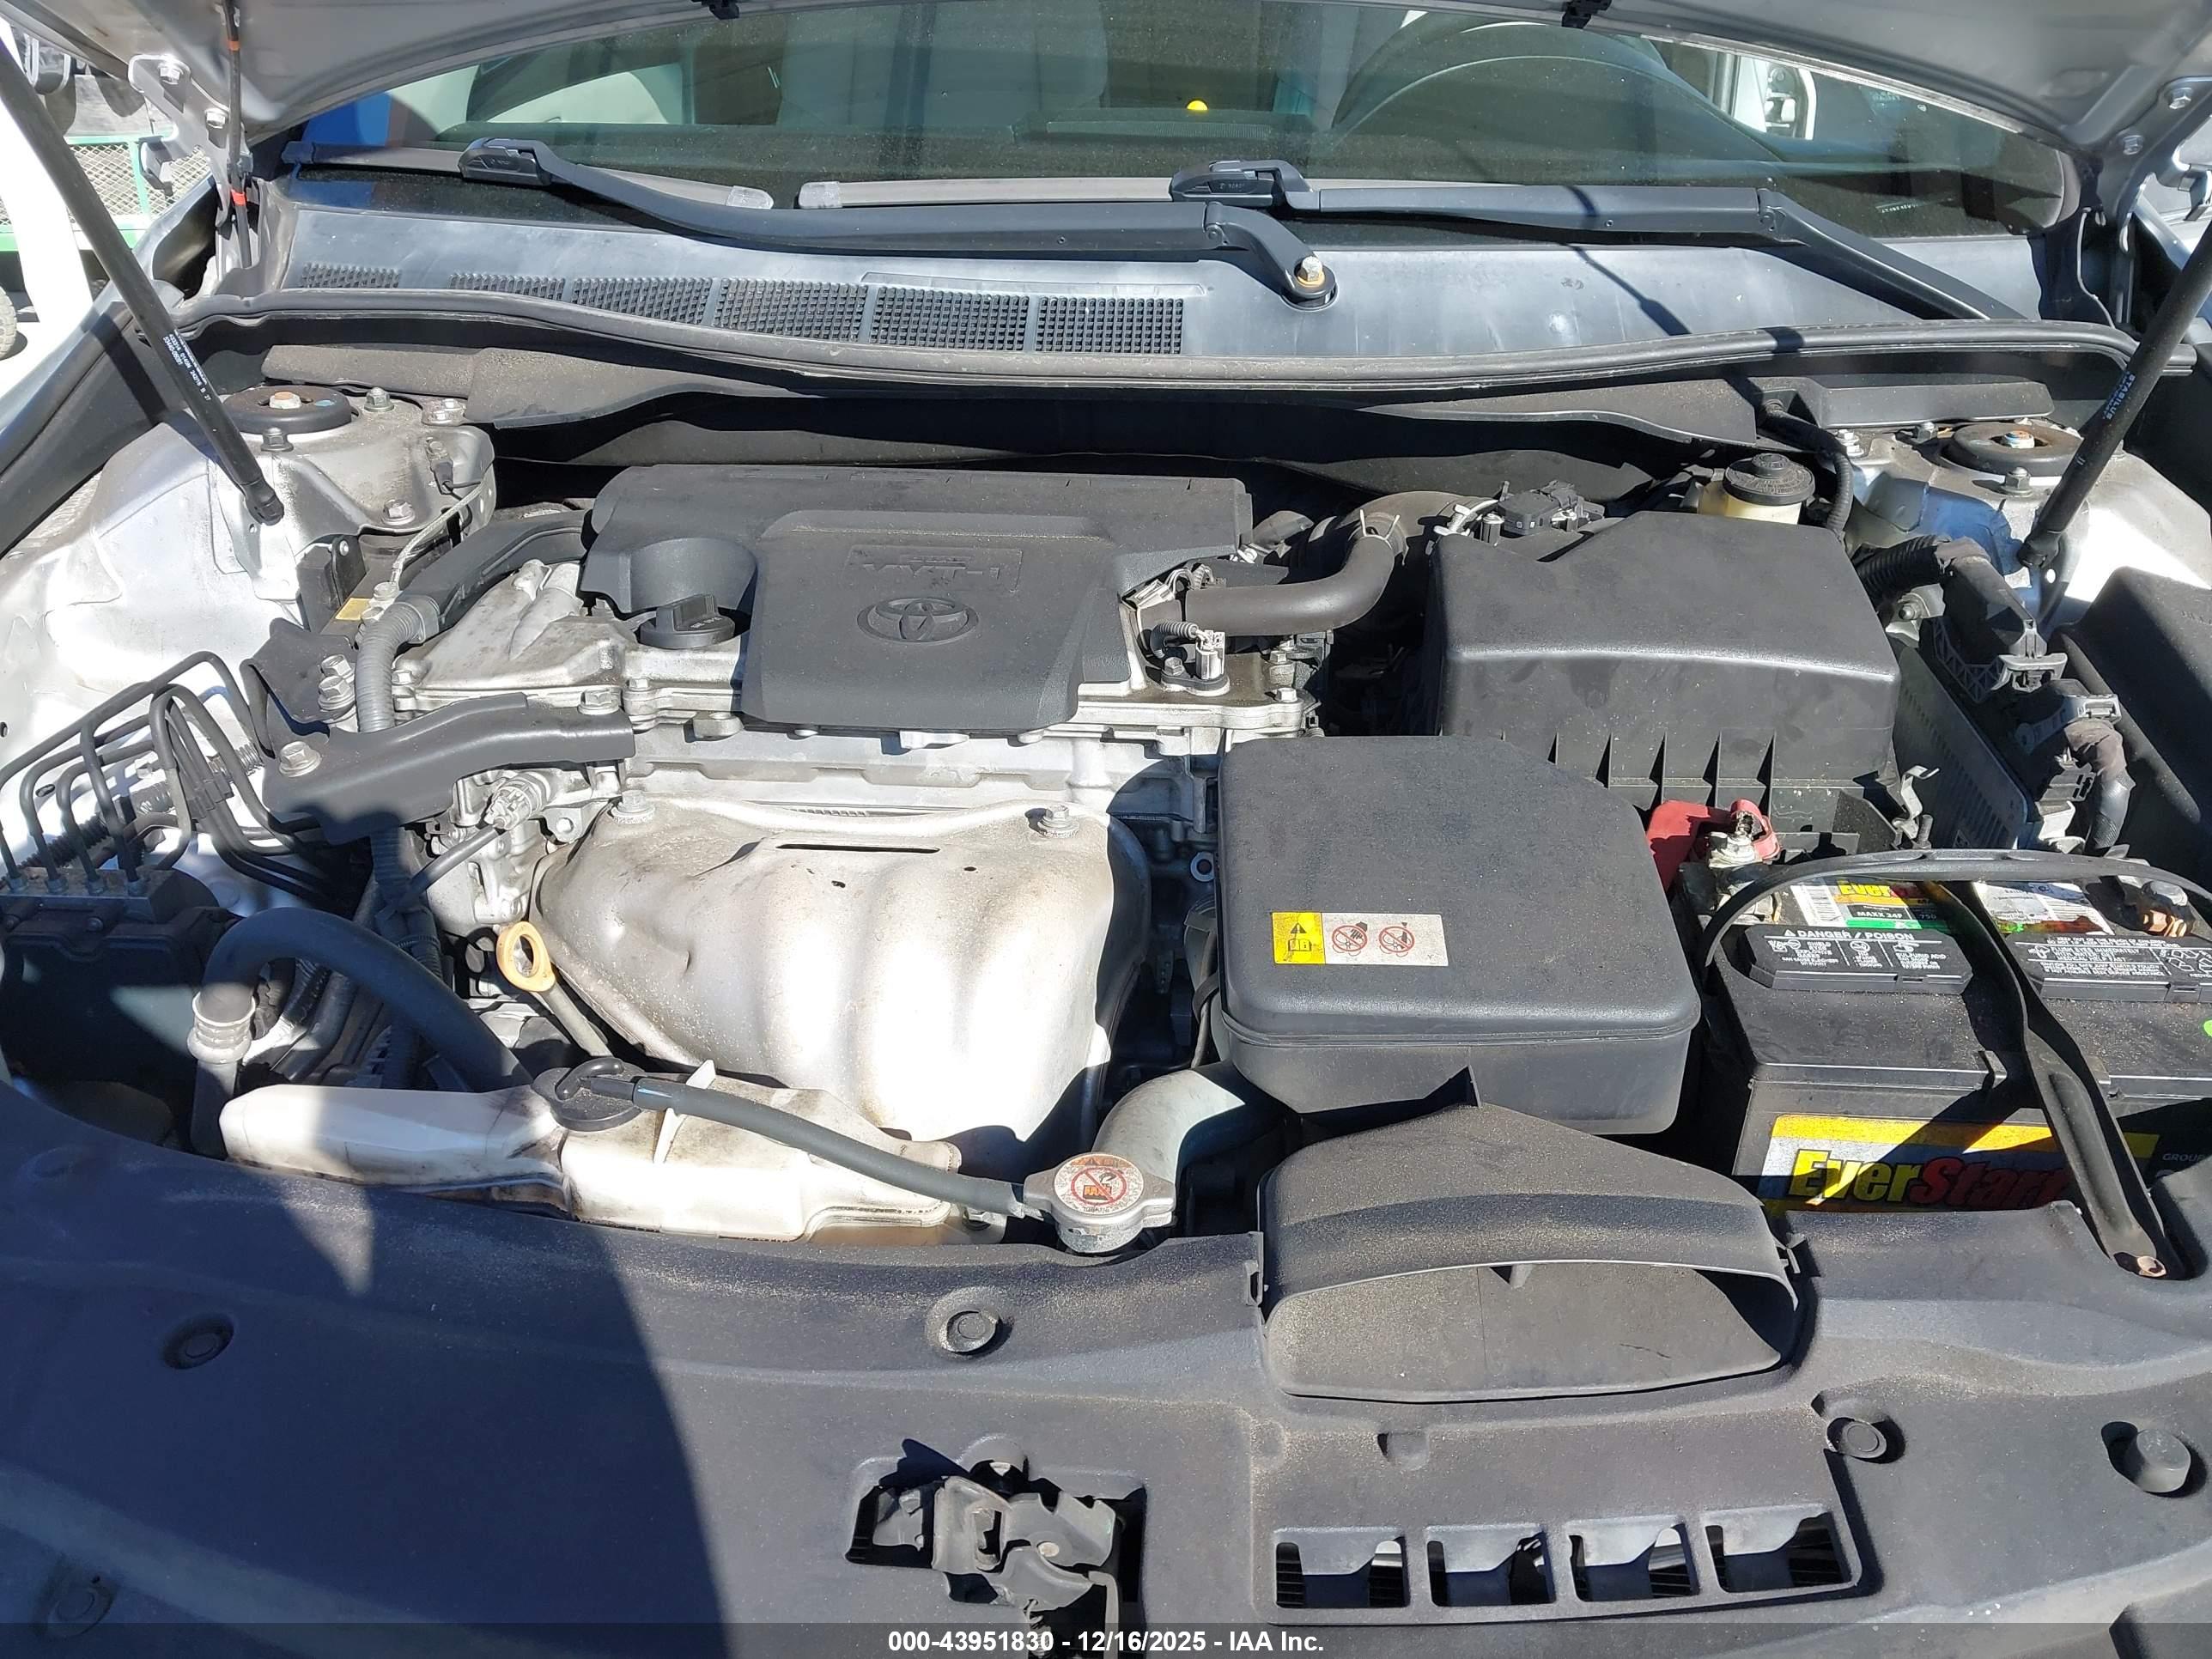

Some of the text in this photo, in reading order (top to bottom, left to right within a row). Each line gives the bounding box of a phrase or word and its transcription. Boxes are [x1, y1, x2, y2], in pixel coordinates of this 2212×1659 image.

[2106, 374, 2136, 419] STABILUS
[1797, 930, 1851, 939] DANGER
[1864, 932, 1914, 940] POISON
